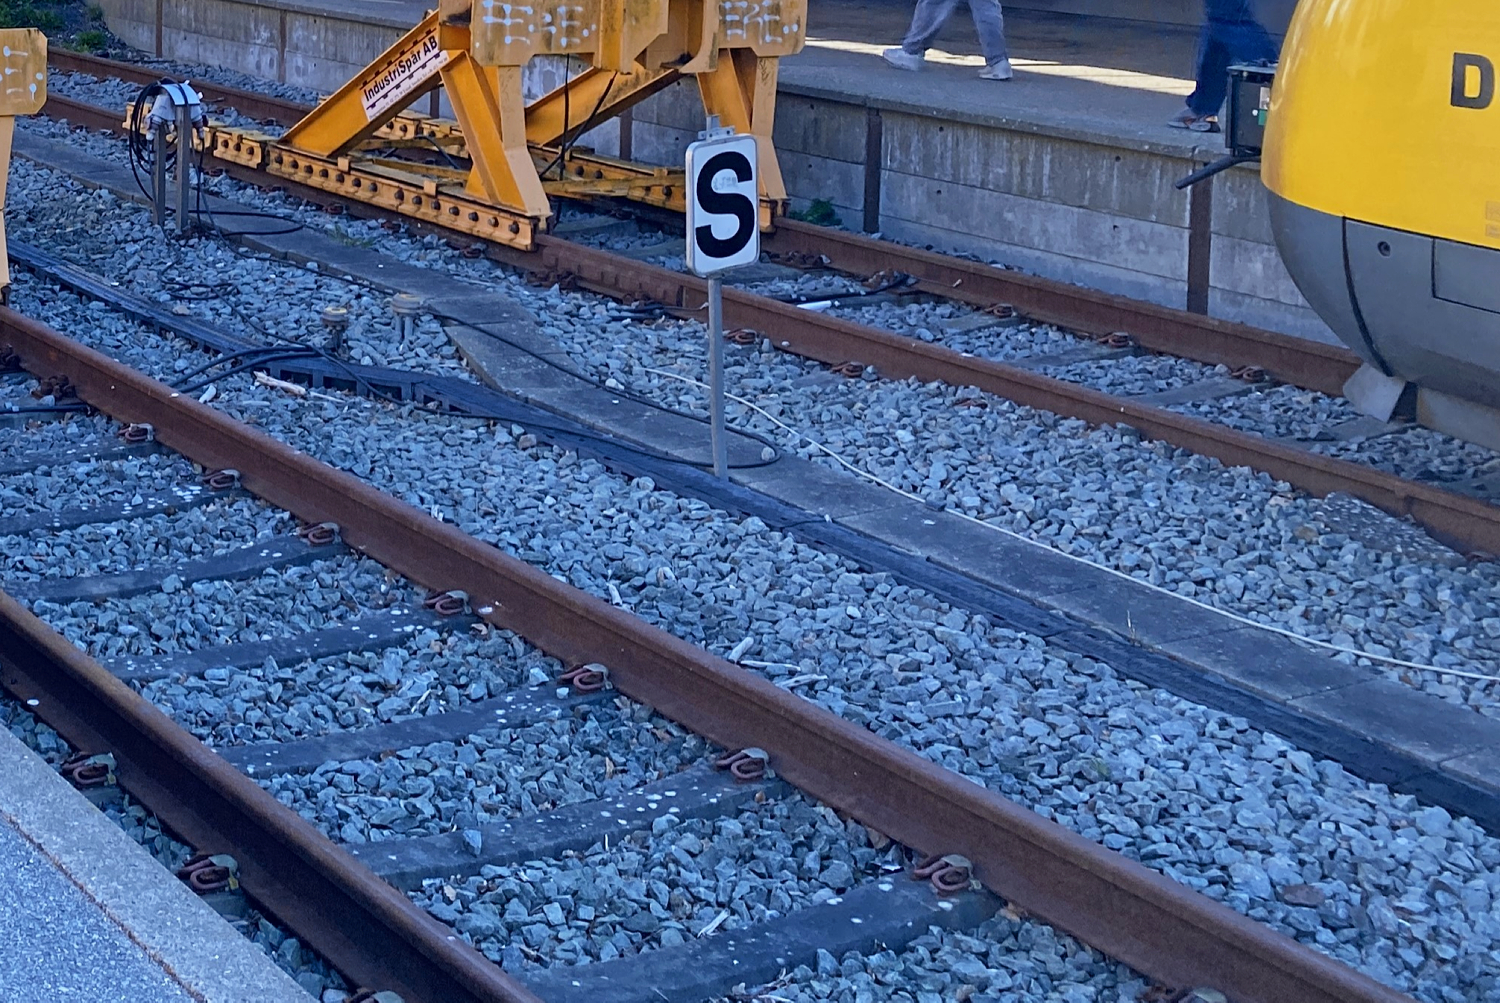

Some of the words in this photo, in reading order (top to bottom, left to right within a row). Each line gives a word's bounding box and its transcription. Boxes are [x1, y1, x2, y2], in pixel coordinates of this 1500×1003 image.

[422, 35, 438, 56] AB
[1450, 52, 1495, 110] D
[695, 151, 755, 258] S
